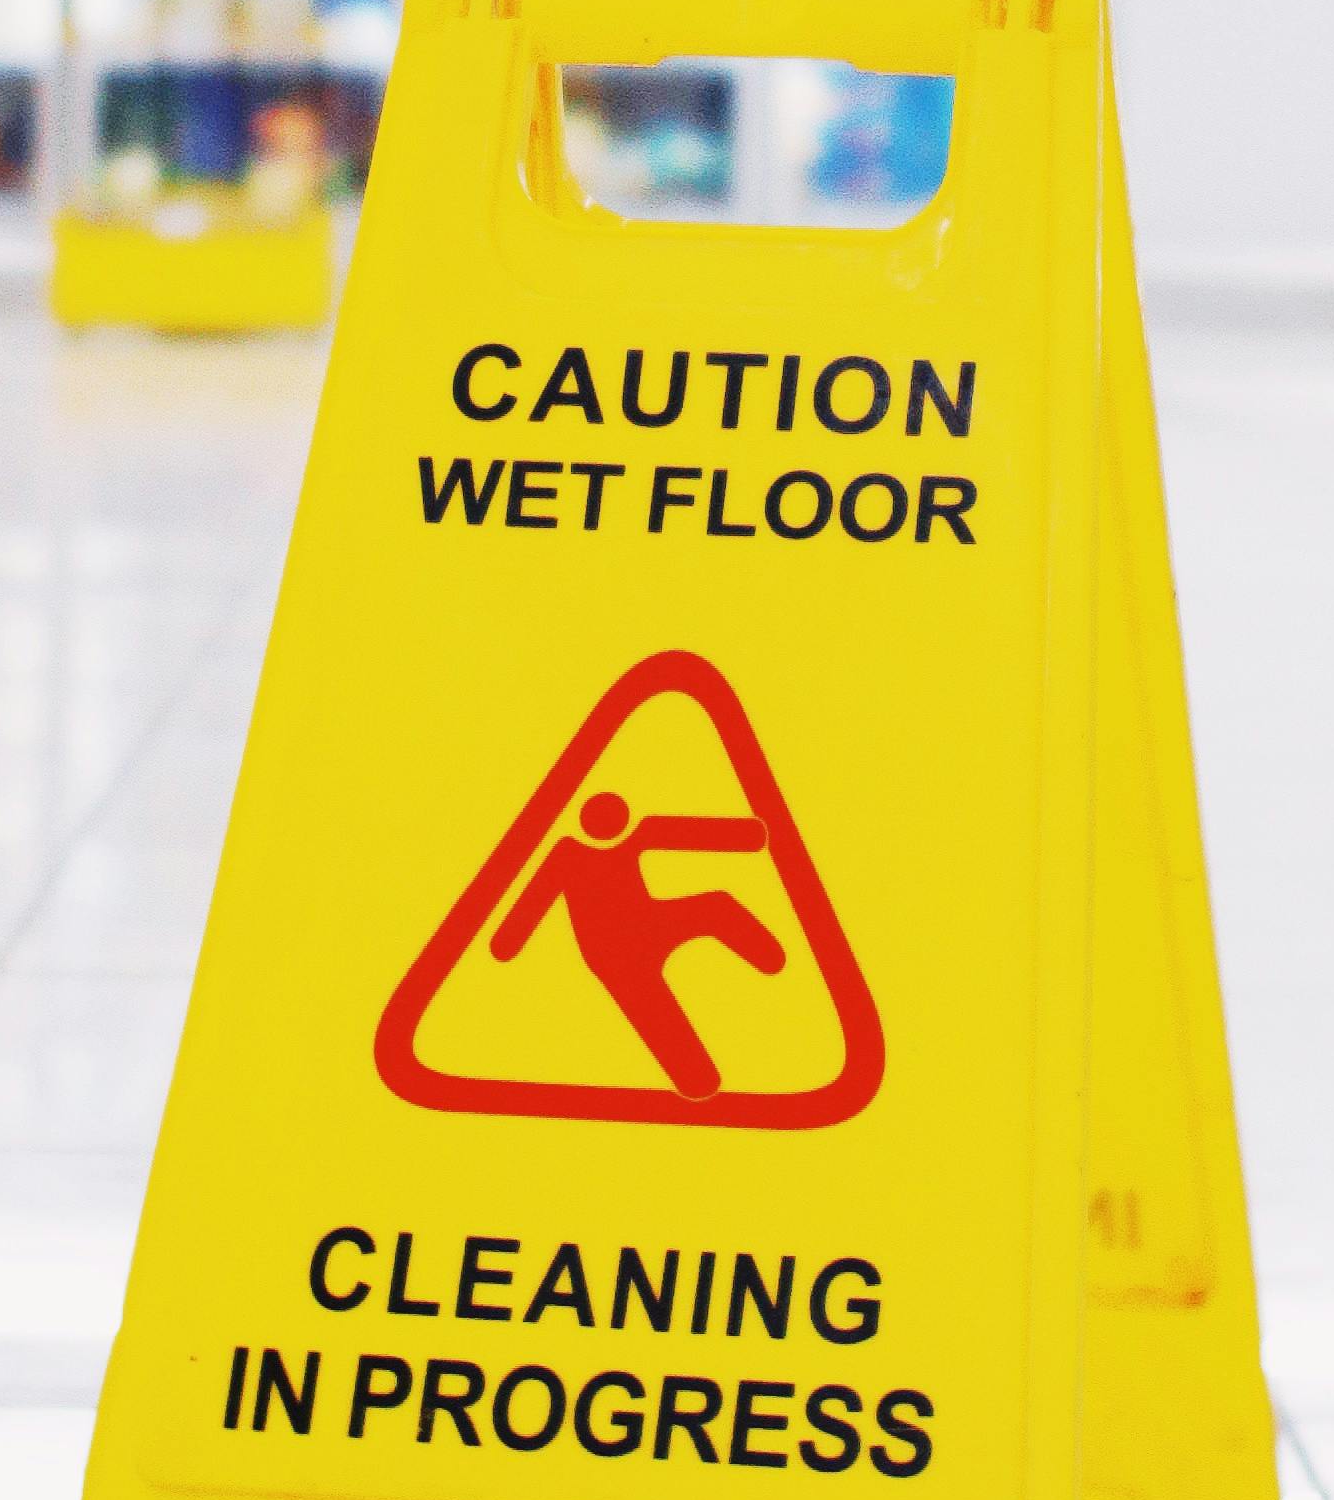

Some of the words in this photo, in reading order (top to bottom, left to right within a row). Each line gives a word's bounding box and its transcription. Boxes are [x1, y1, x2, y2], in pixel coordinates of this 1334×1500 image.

[451, 342, 978, 438] CAUTION
[417, 456, 627, 532] WET
[647, 465, 978, 546] FLOOR
[308, 1226, 883, 1346] CLEANING
[222, 1346, 322, 1436] IN
[346, 1354, 935, 1480] PROGRESS
